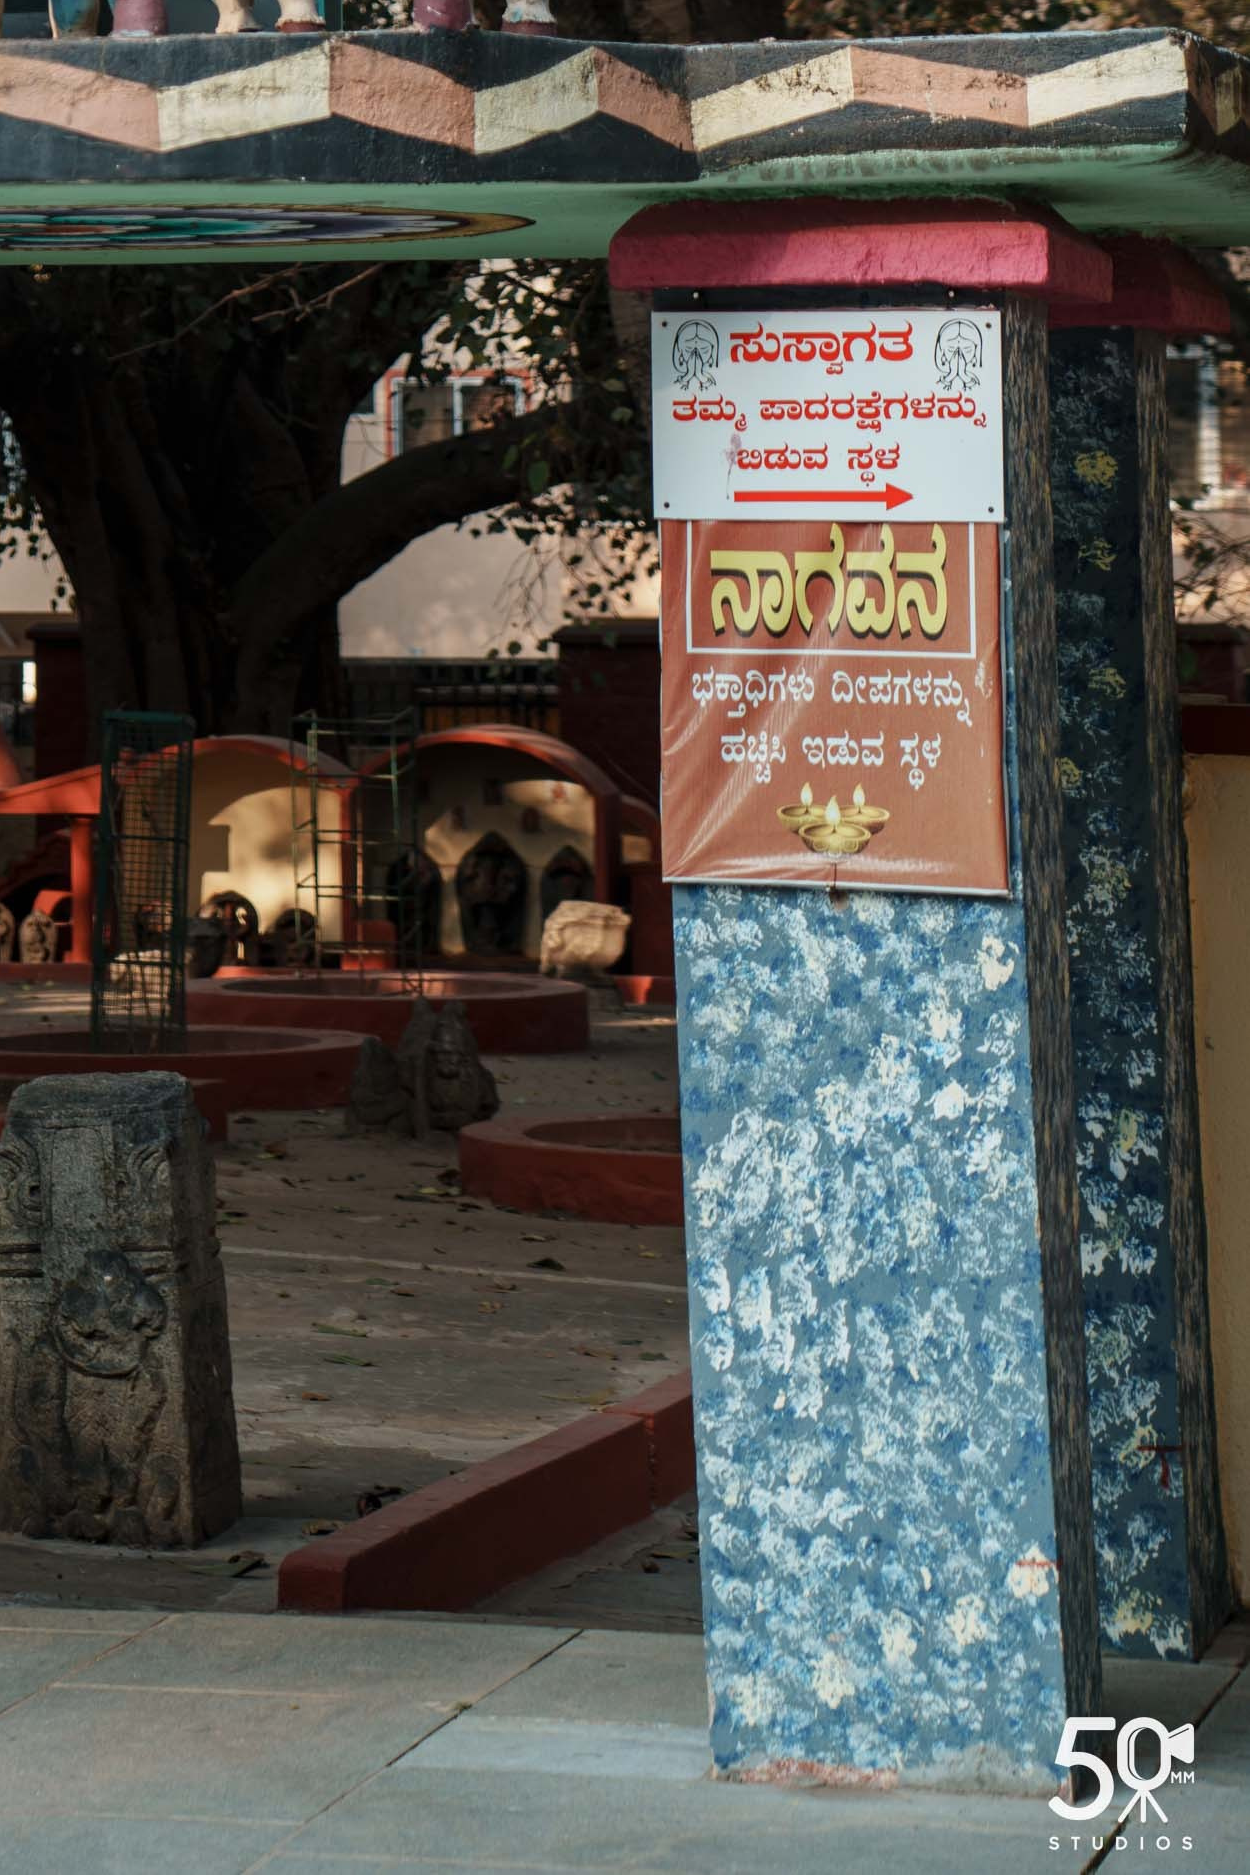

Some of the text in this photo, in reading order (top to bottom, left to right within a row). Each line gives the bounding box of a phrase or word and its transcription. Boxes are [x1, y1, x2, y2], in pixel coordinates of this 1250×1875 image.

[729, 321, 914, 375] ಸುಸ್ವಾಗತ
[672, 390, 987, 432] ತಮ್ಮ ಪಾದರಕ್ಷೆಗಳನ್ನು
[736, 441, 900, 487] ಬಿಡುವ ಸ್ಥಳ
[709, 522, 948, 639] ನಾಗವನ
[692, 665, 973, 727] ಭಕ್ತಾಧಿಗಳು ದೀಪಗಳನ್ನು
[720, 728, 943, 792] ಹಚ್ಚಿಸಿ ಇಡುವ ಸ್ಥಳ
